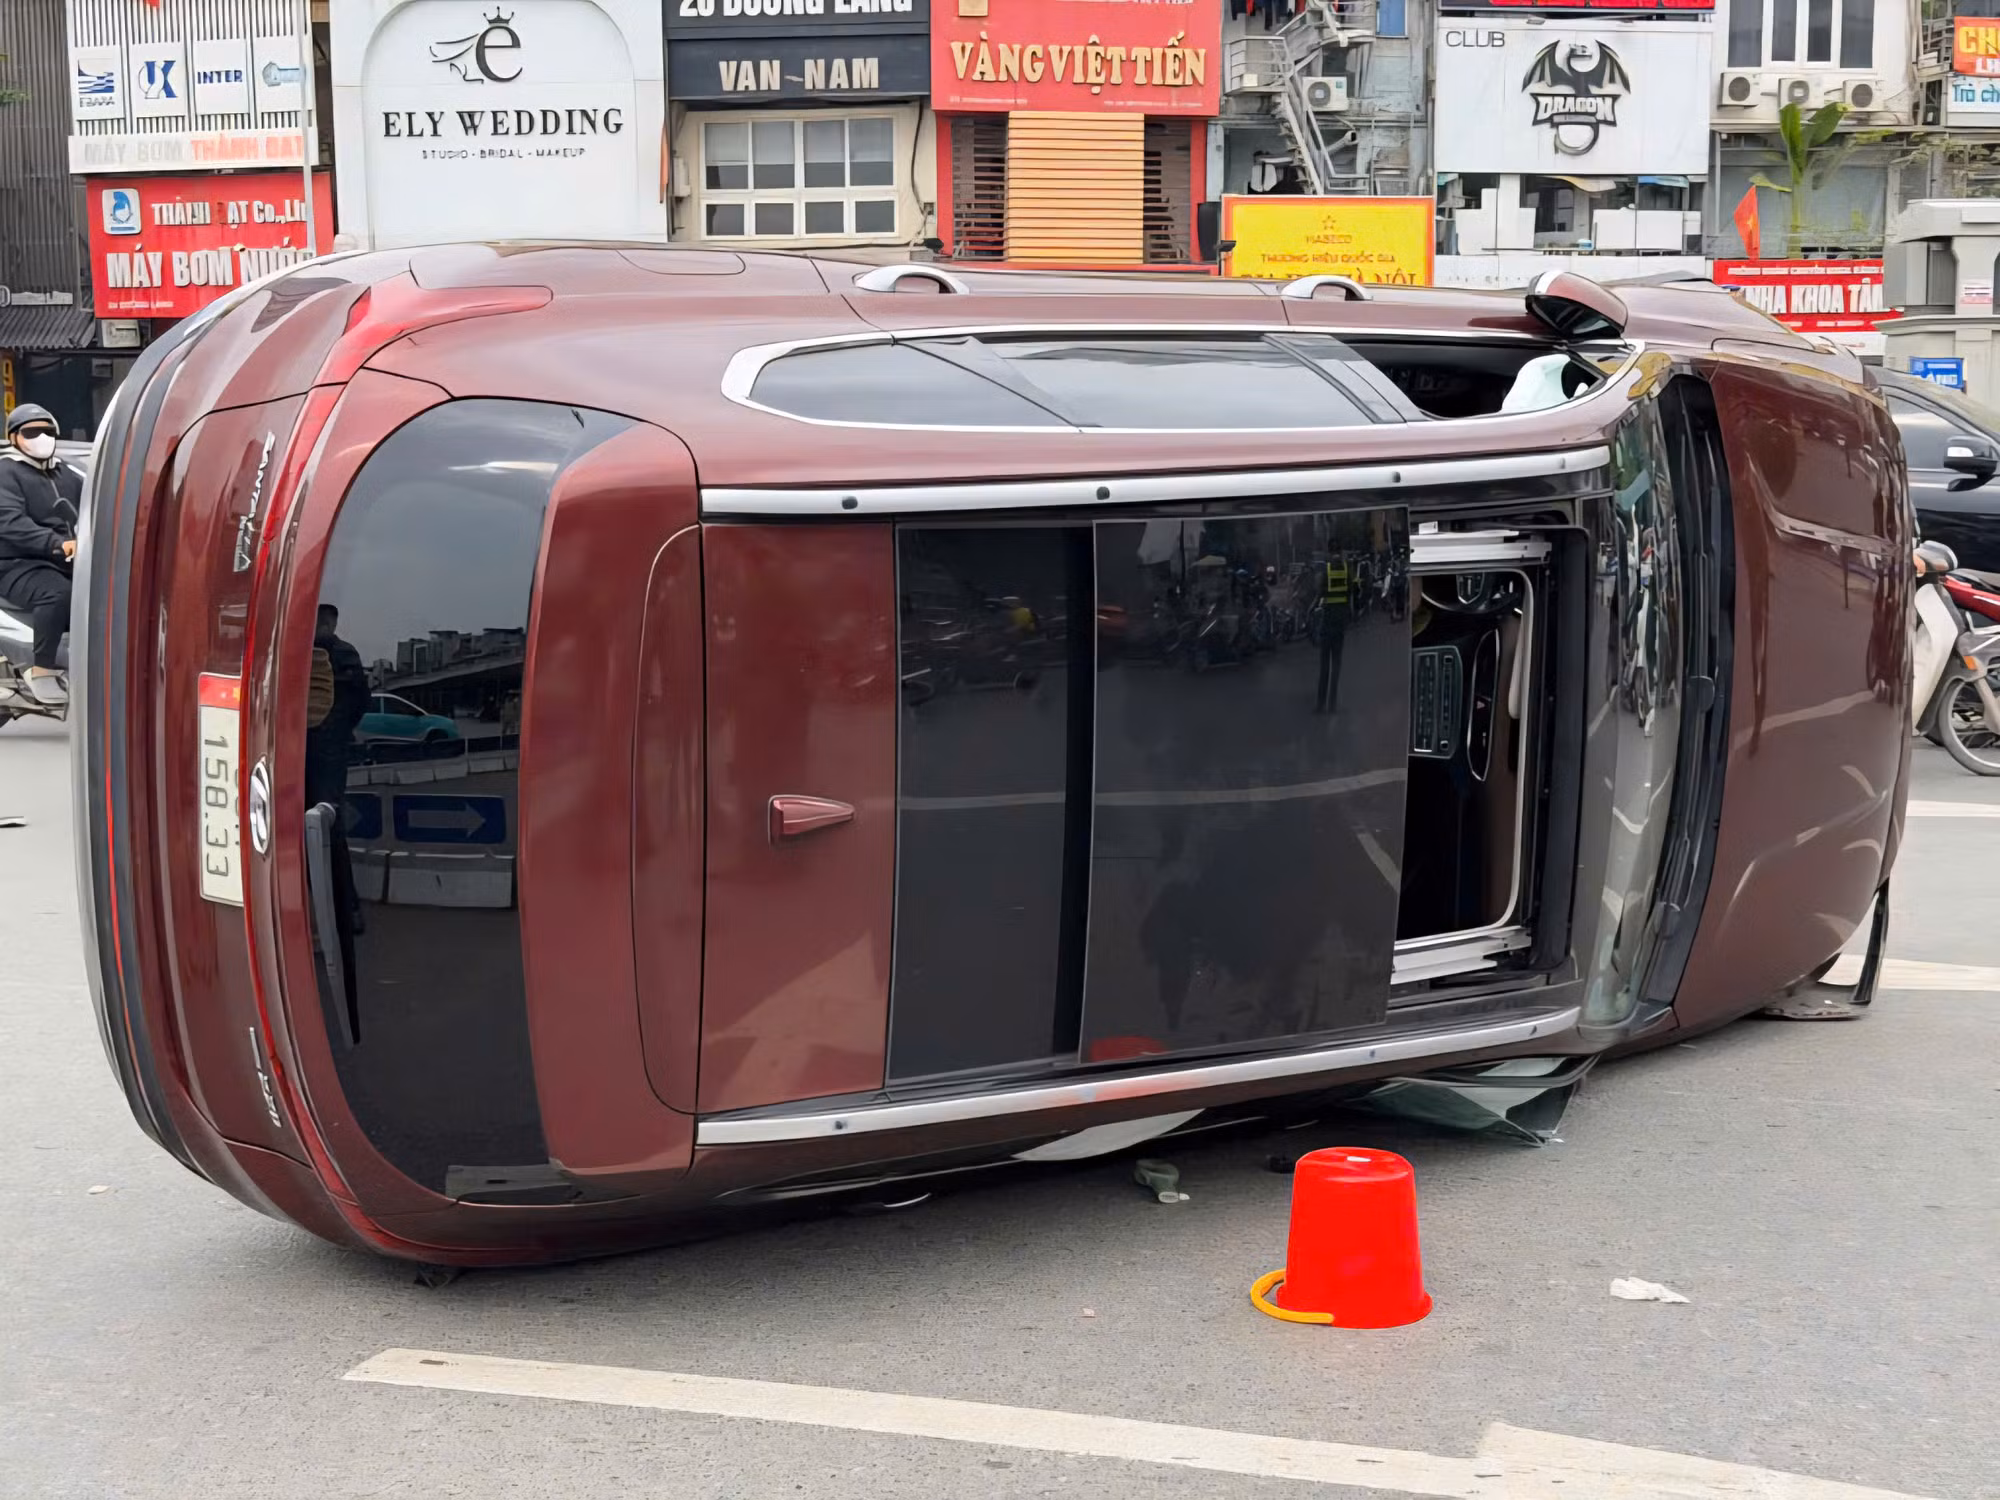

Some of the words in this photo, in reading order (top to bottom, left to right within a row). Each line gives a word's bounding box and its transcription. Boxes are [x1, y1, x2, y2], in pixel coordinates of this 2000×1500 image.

[1445, 31, 1505, 47] CLUB
[197, 70, 243, 84] INTER
[719, 60, 781, 91] VAN
[804, 57, 879, 90] NAM
[950, 30, 1045, 83] VÀNG
[1048, 33, 1126, 95] VIỆT
[1131, 29, 1206, 86] TIẾN
[383, 111, 445, 138] ELY
[456, 108, 623, 137] WEDDING
[1537, 95, 1614, 121] DRAGON
[106, 243, 163, 288] MÁY
[1791, 284, 1844, 313] KHOA
[204, 735, 229, 877] 158.33
